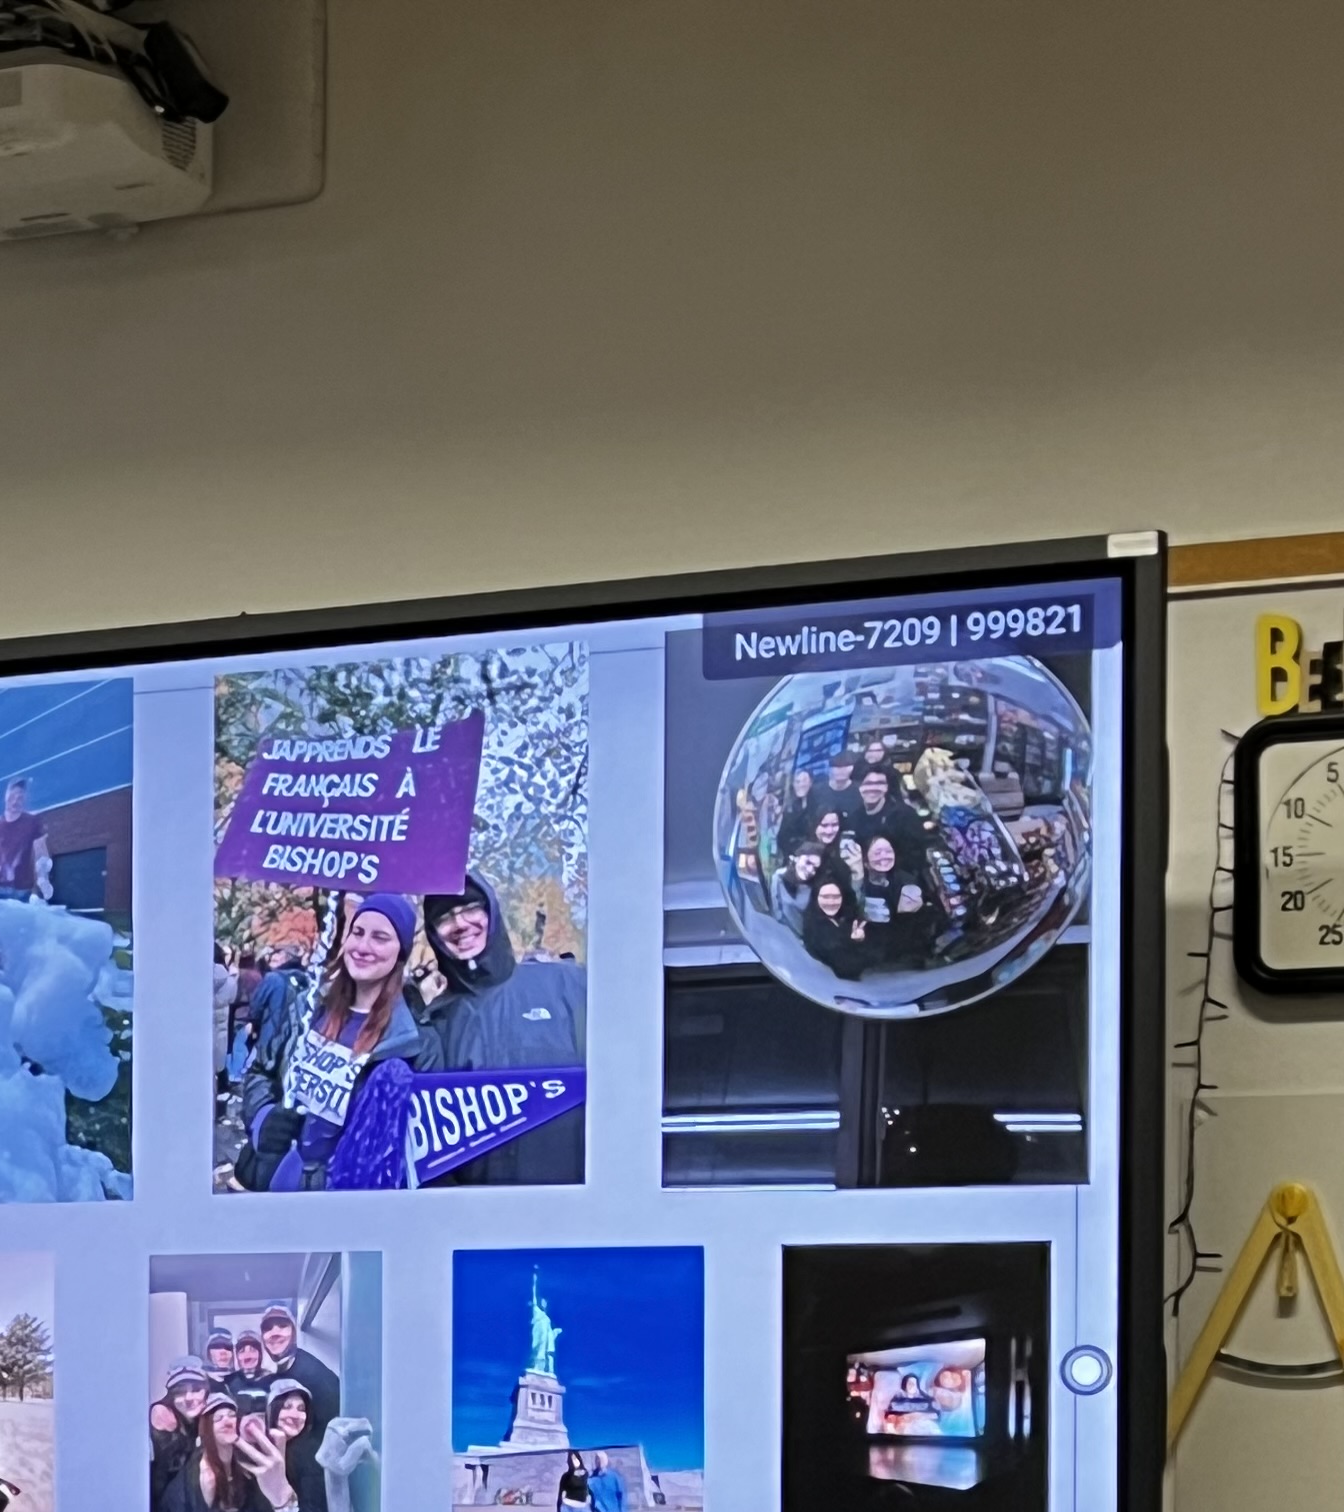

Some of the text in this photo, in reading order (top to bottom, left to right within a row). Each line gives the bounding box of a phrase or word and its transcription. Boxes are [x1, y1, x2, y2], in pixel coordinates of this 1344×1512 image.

[735, 615, 941, 661] Newline-7209
[967, 603, 1081, 641] 999821
[1326, 761, 1339, 783] 5
[262, 766, 416, 808] FRANÇAIS À
[1282, 797, 1305, 819] 10
[262, 844, 379, 884] BISHOP'S
[1270, 846, 1293, 867] 15
[1281, 890, 1305, 911] 20
[1319, 924, 1343, 945] 25
[406, 1080, 566, 1162] BISHOP'S
